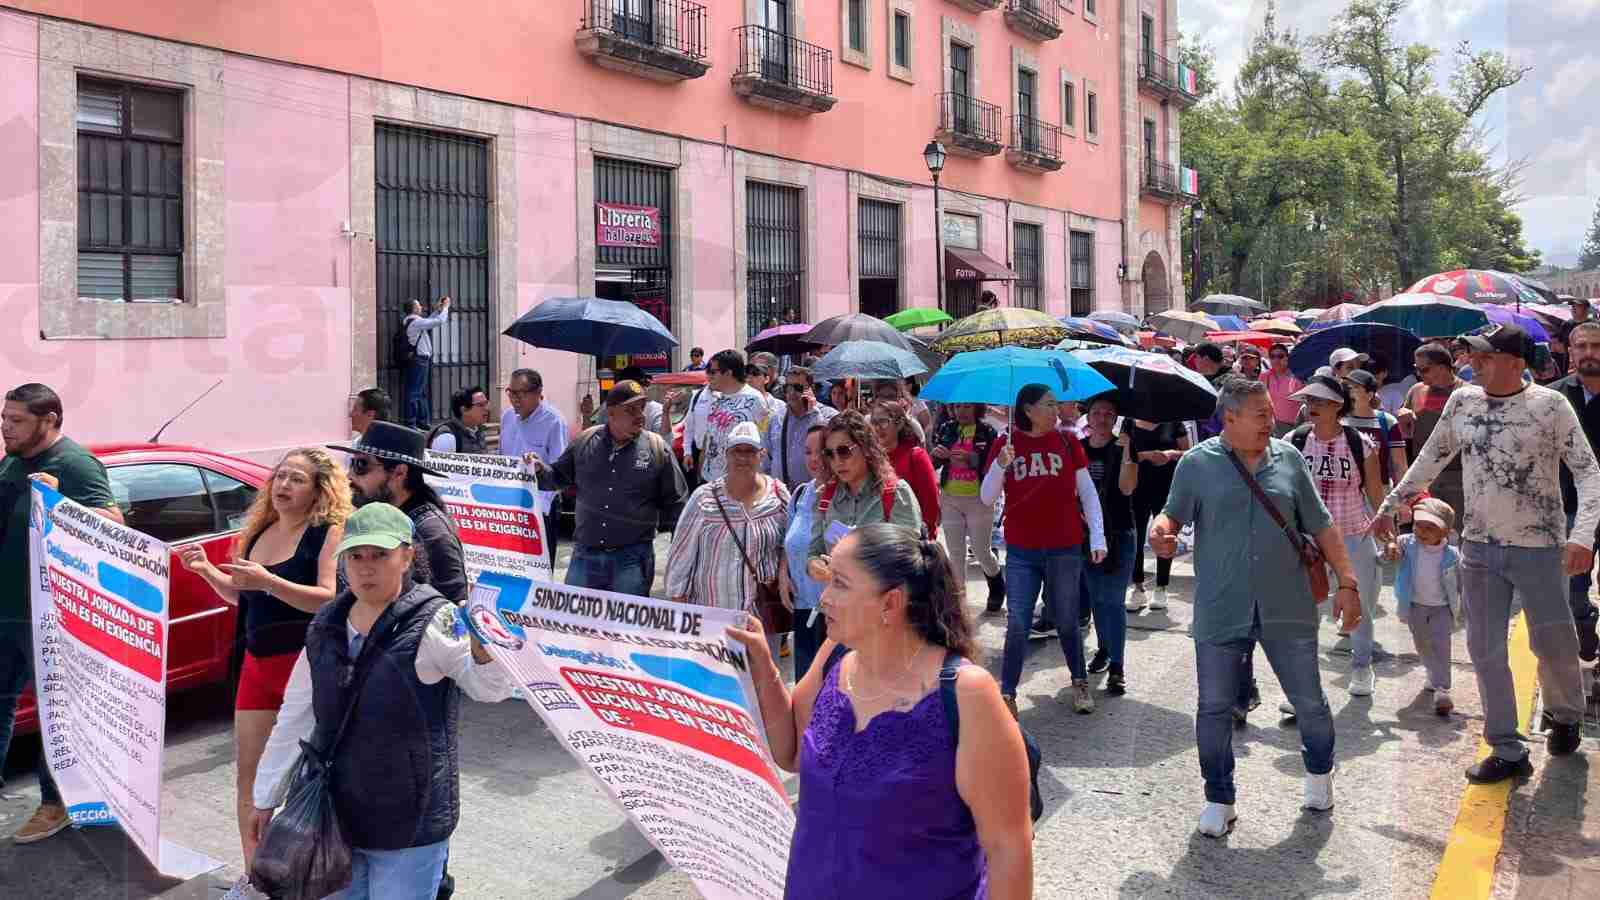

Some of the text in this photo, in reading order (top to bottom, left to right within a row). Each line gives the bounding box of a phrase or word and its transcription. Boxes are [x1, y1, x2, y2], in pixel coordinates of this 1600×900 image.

[471, 468, 482, 477] DE
[483, 469, 491, 478] LA
[1013, 452, 1063, 481] GAP
[58, 502, 150, 553] SINDICATO NACIONAL DE
[461, 519, 473, 529] ES
[474, 520, 488, 531] EN
[489, 521, 538, 540] EXIGENCIA
[471, 508, 516, 522] JORNADA
[518, 513, 529, 524] DE
[107, 545, 119, 559] LA
[120, 548, 169, 578] EDUCACIÓN
[50, 572, 89, 603] NUESTRA
[91, 593, 135, 629] JORNADA
[138, 618, 155, 634] DE
[532, 586, 703, 636] SINDICATO NACIONAL DE
[79, 605, 91, 622] ES
[92, 612, 105, 631] EN
[106, 618, 161, 658] EXIGENCIA
[651, 637, 747, 672] EDUCACIÓN
[569, 670, 654, 698] NUESTRA
[654, 686, 740, 728] JORNADA
[580, 690, 647, 715] LUCHA
[644, 701, 671, 720] ES
[668, 708, 699, 729] EN
